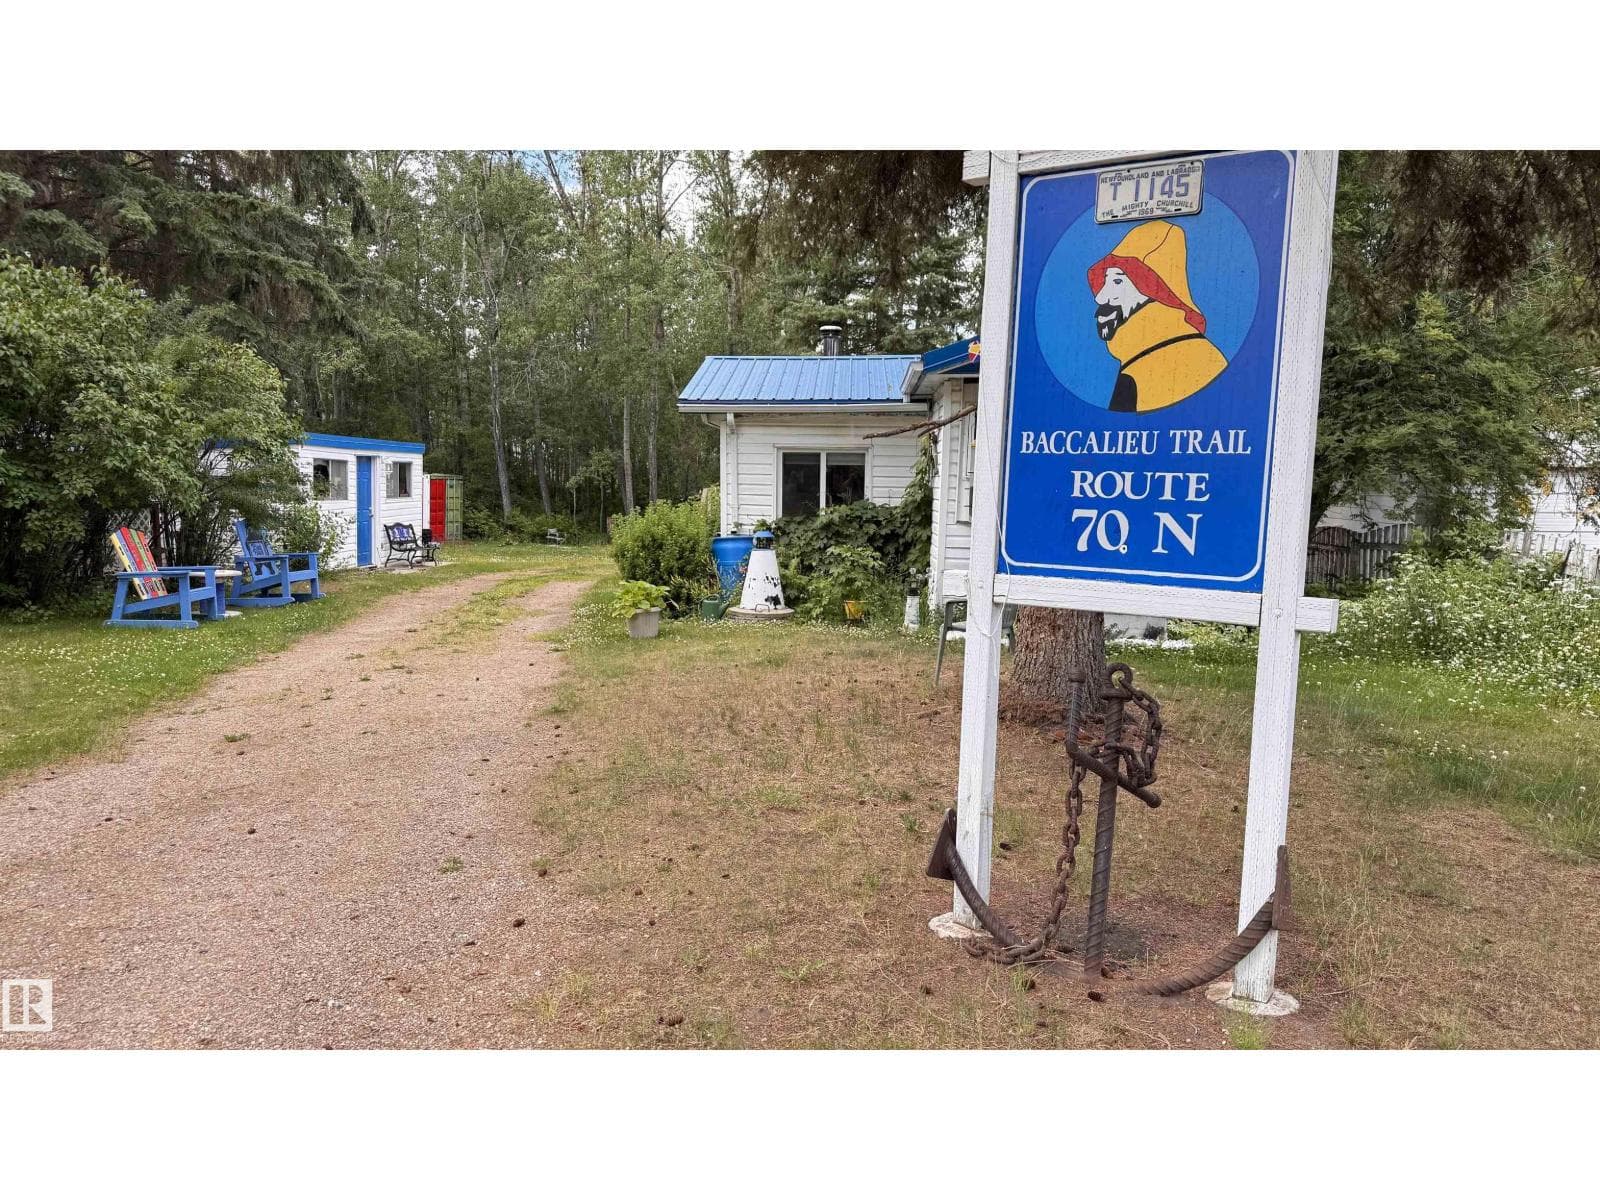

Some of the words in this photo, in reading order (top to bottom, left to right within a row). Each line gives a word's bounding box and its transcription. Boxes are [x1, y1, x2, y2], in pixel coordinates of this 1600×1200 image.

[1100, 172, 1149, 184] NEWFOUNDLAND
[1151, 170, 1165, 178] AND
[1110, 182, 1121, 201] T
[1134, 174, 1190, 202] 1145
[1102, 209, 1114, 219] THE
[1122, 201, 1149, 211] MIGHTY
[1156, 200, 1194, 208] CHURCHILL
[1019, 430, 1159, 455] BACCALIEU
[1169, 429, 1251, 455] TRAIL
[1070, 470, 1210, 502] ROUTE
[1070, 509, 1130, 552] 70
[1152, 511, 1204, 556] N
